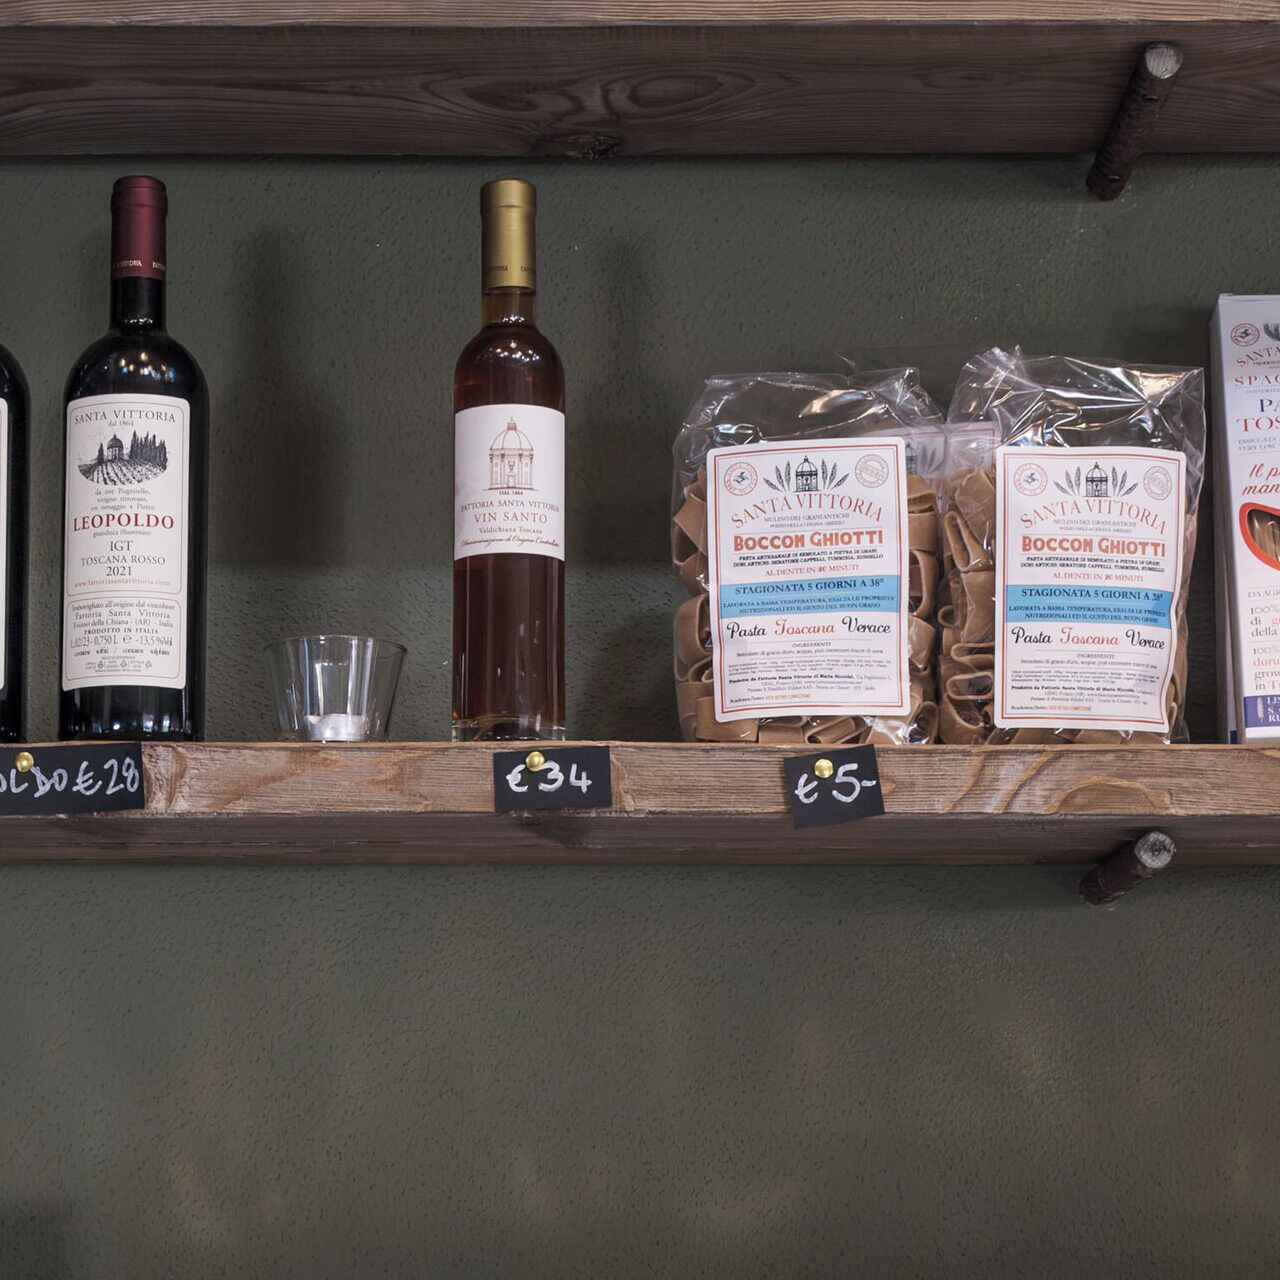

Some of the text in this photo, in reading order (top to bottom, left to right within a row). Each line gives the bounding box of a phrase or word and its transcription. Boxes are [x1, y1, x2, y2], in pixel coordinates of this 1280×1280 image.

[75, 409, 176, 425] SANTA VITTORIA
[474, 512, 548, 524] VIN SANTO
[730, 491, 883, 528] SANTA VITTORIA
[1020, 499, 1167, 535] SANTA VITTORIA
[73, 513, 175, 532] LEOPOLDO
[109, 541, 133, 552] IGT
[733, 530, 883, 551] BOCCON GHIOTTI
[1021, 535, 1166, 557] BOCCON GHIOTTI
[81, 556, 166, 567] TOSCANA ROSSO
[735, 579, 857, 595] STAGIONATA GIORNI
[1021, 588, 1091, 599] STAGIONATA
[727, 616, 891, 639] Pasta Toscana Verace
[1011, 626, 1165, 649] Pasta Toscana Verace
